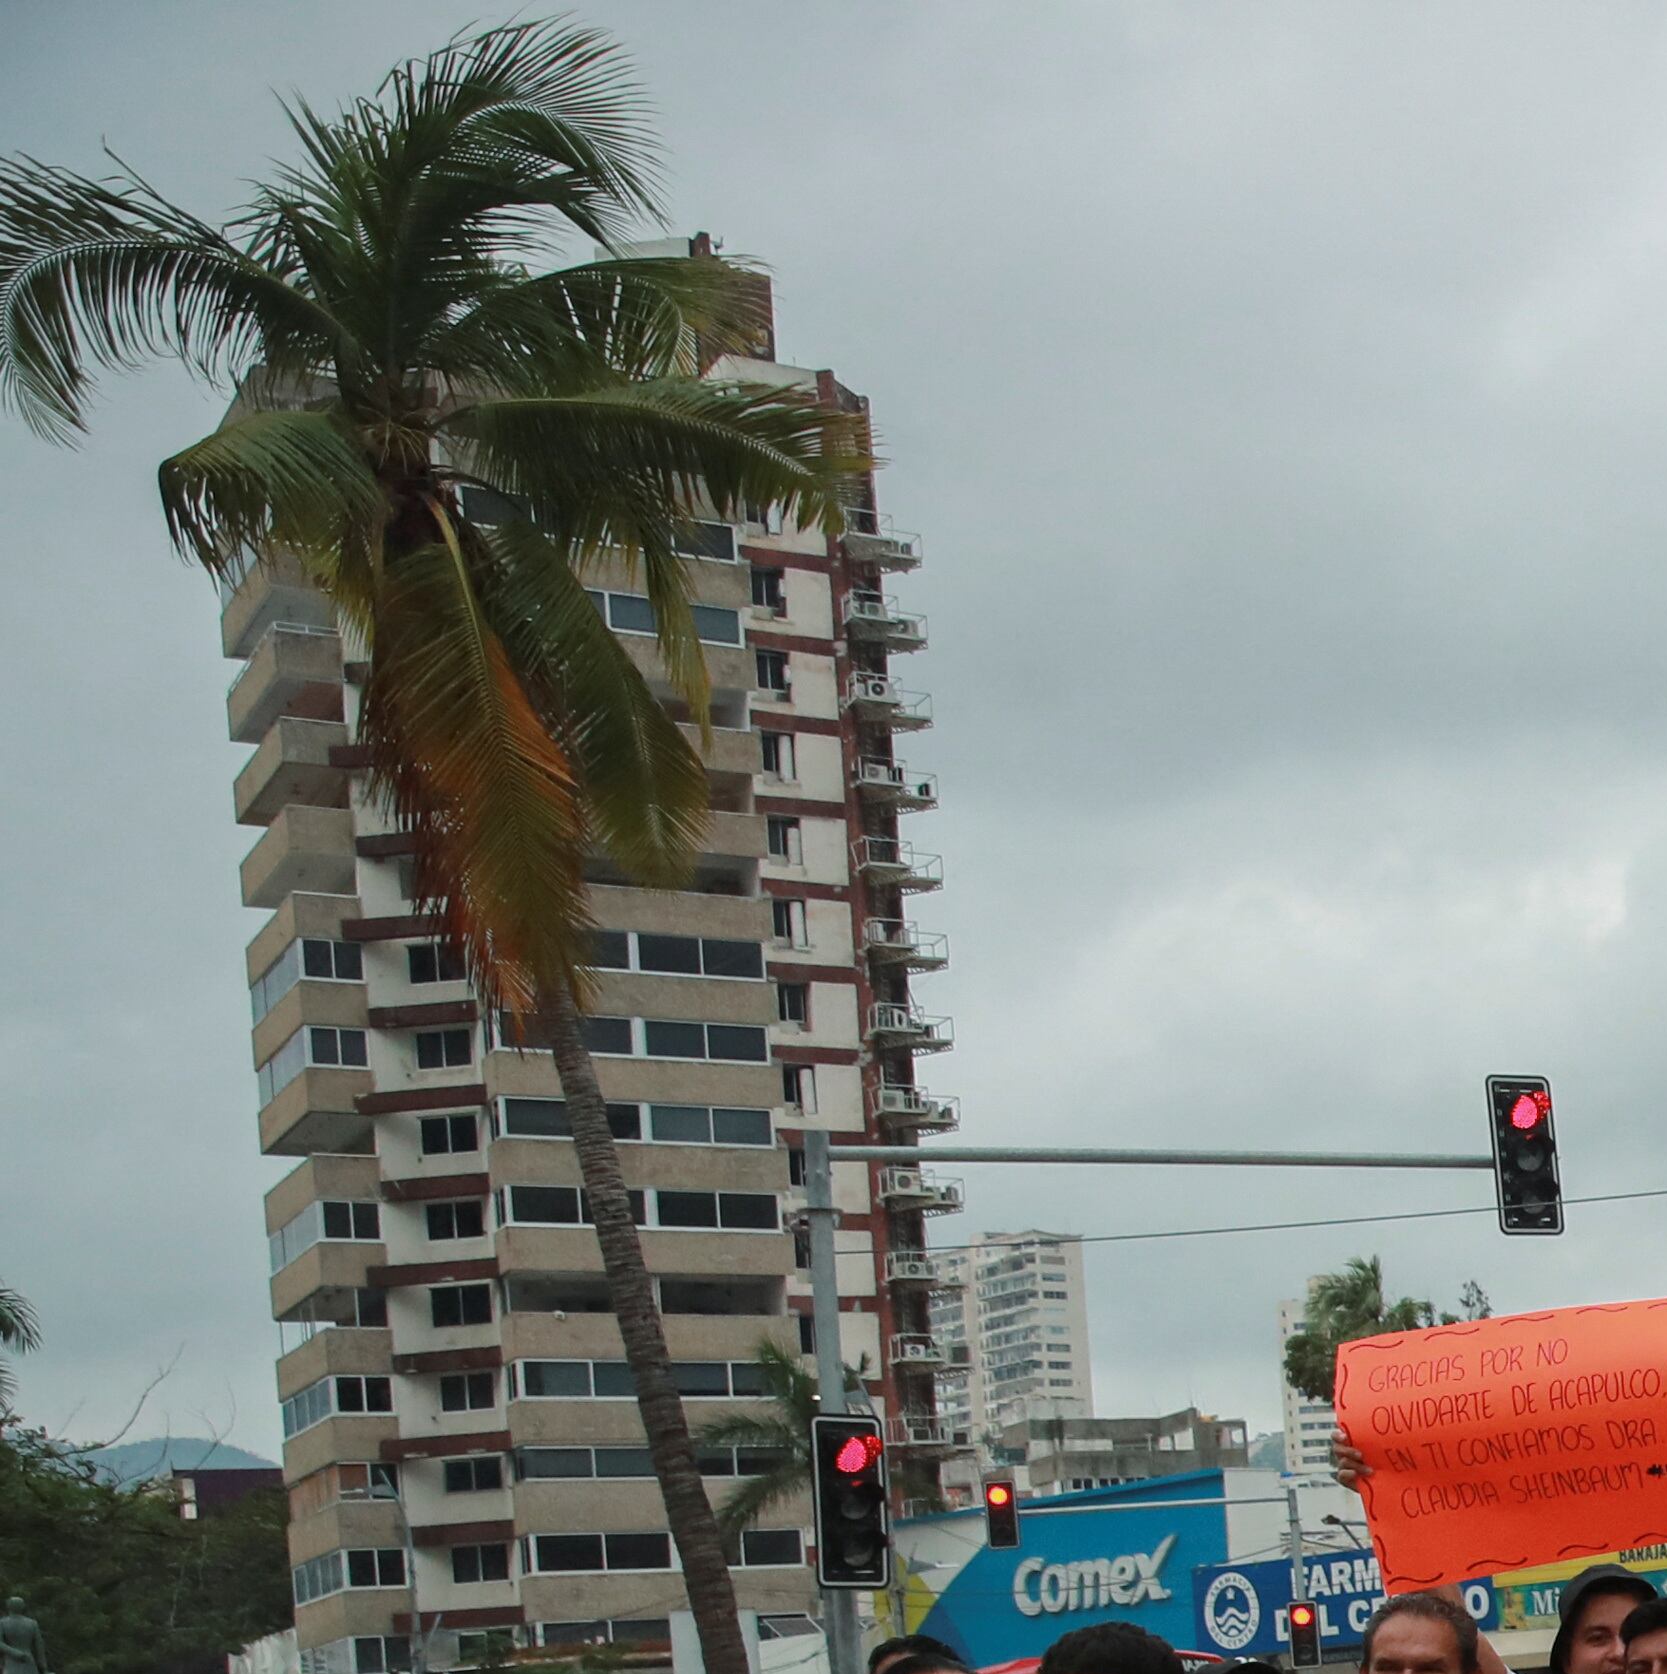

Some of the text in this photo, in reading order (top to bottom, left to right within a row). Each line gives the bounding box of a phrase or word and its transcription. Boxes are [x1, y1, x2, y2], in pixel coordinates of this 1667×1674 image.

[1369, 1338, 1568, 1392] GRACIAS POR NO
[1372, 1389, 1493, 1435] OLVIDARTE
[1512, 1383, 1536, 1416] DE
[1386, 1448, 1414, 1472] EN
[1424, 1443, 1447, 1470] TI
[1458, 1424, 1595, 1468] CONFIAMOS
[1402, 1462, 1642, 1518] CLAUDIA SHEINBAUM
